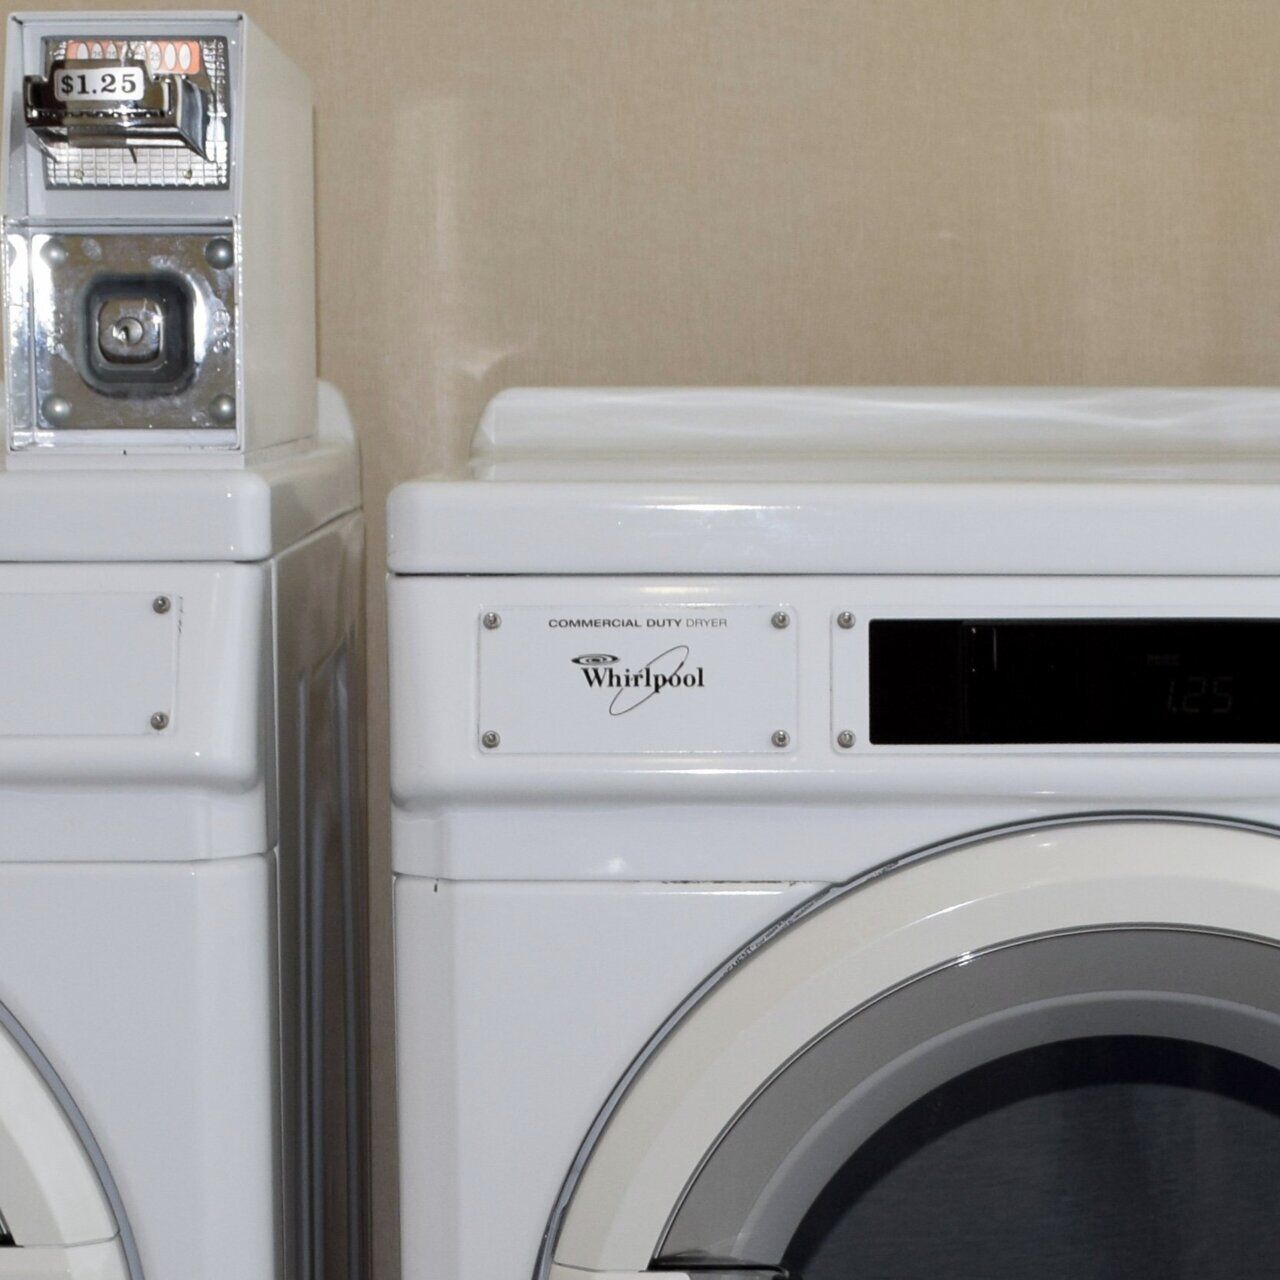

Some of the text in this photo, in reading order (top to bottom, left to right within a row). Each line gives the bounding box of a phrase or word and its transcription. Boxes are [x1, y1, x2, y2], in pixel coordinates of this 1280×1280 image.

[60, 73, 137, 97] $1.25
[548, 618, 728, 629] COMMERCIAL DUTY DRYER
[581, 667, 705, 693] Whirlpool
